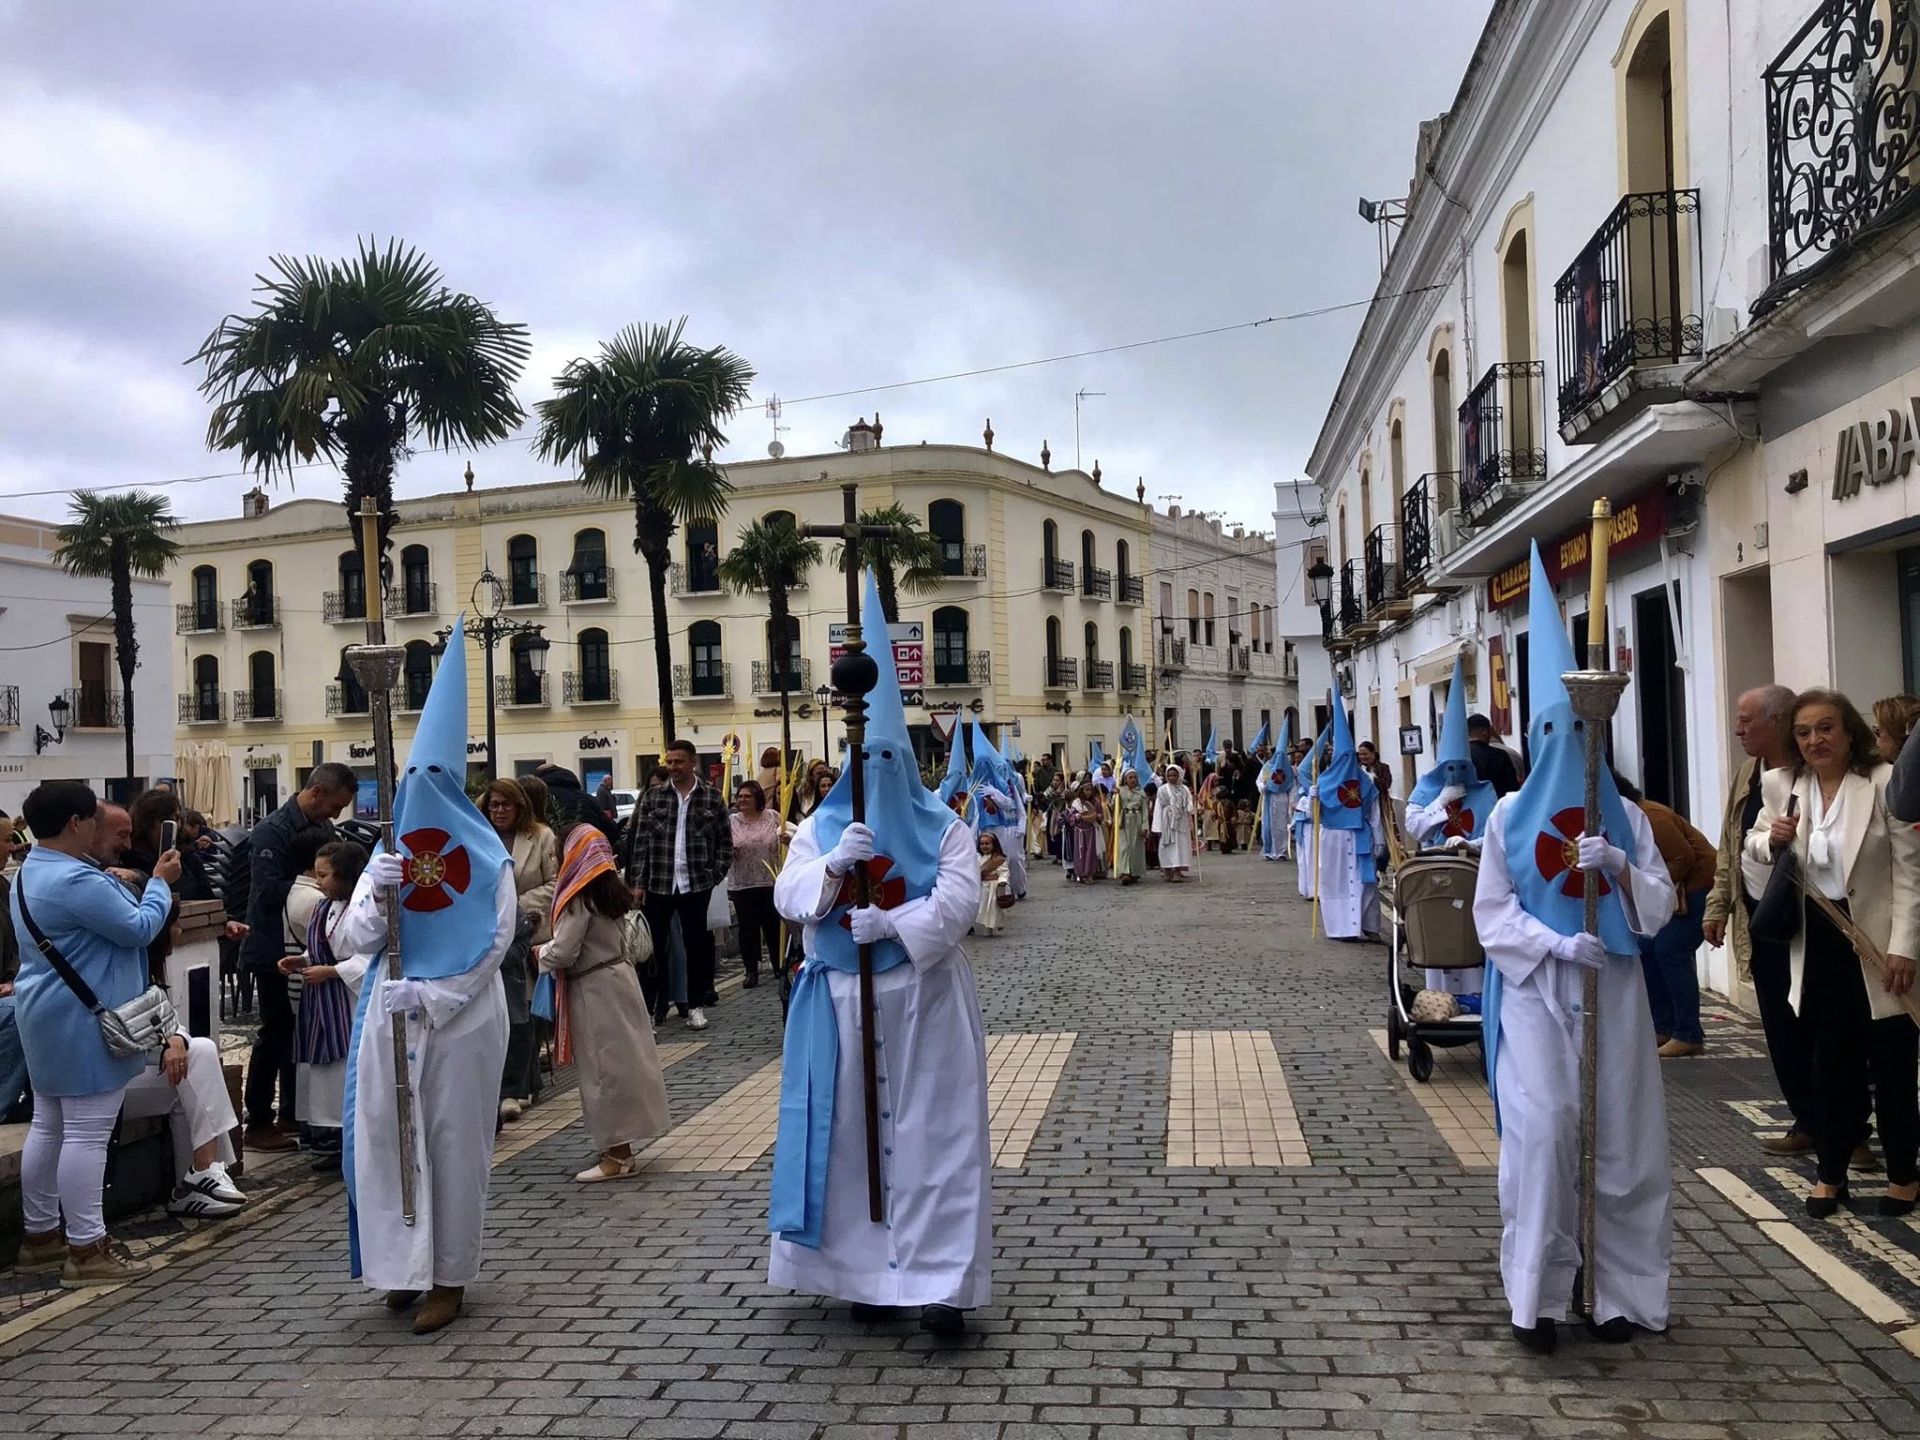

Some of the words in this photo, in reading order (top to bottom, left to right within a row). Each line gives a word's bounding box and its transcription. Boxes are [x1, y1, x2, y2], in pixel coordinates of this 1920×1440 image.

[1608, 503, 1639, 547] PASEOS
[1501, 560, 1529, 591] TABACO
[579, 736, 611, 750] BBVA
[243, 754, 278, 769] clarel
